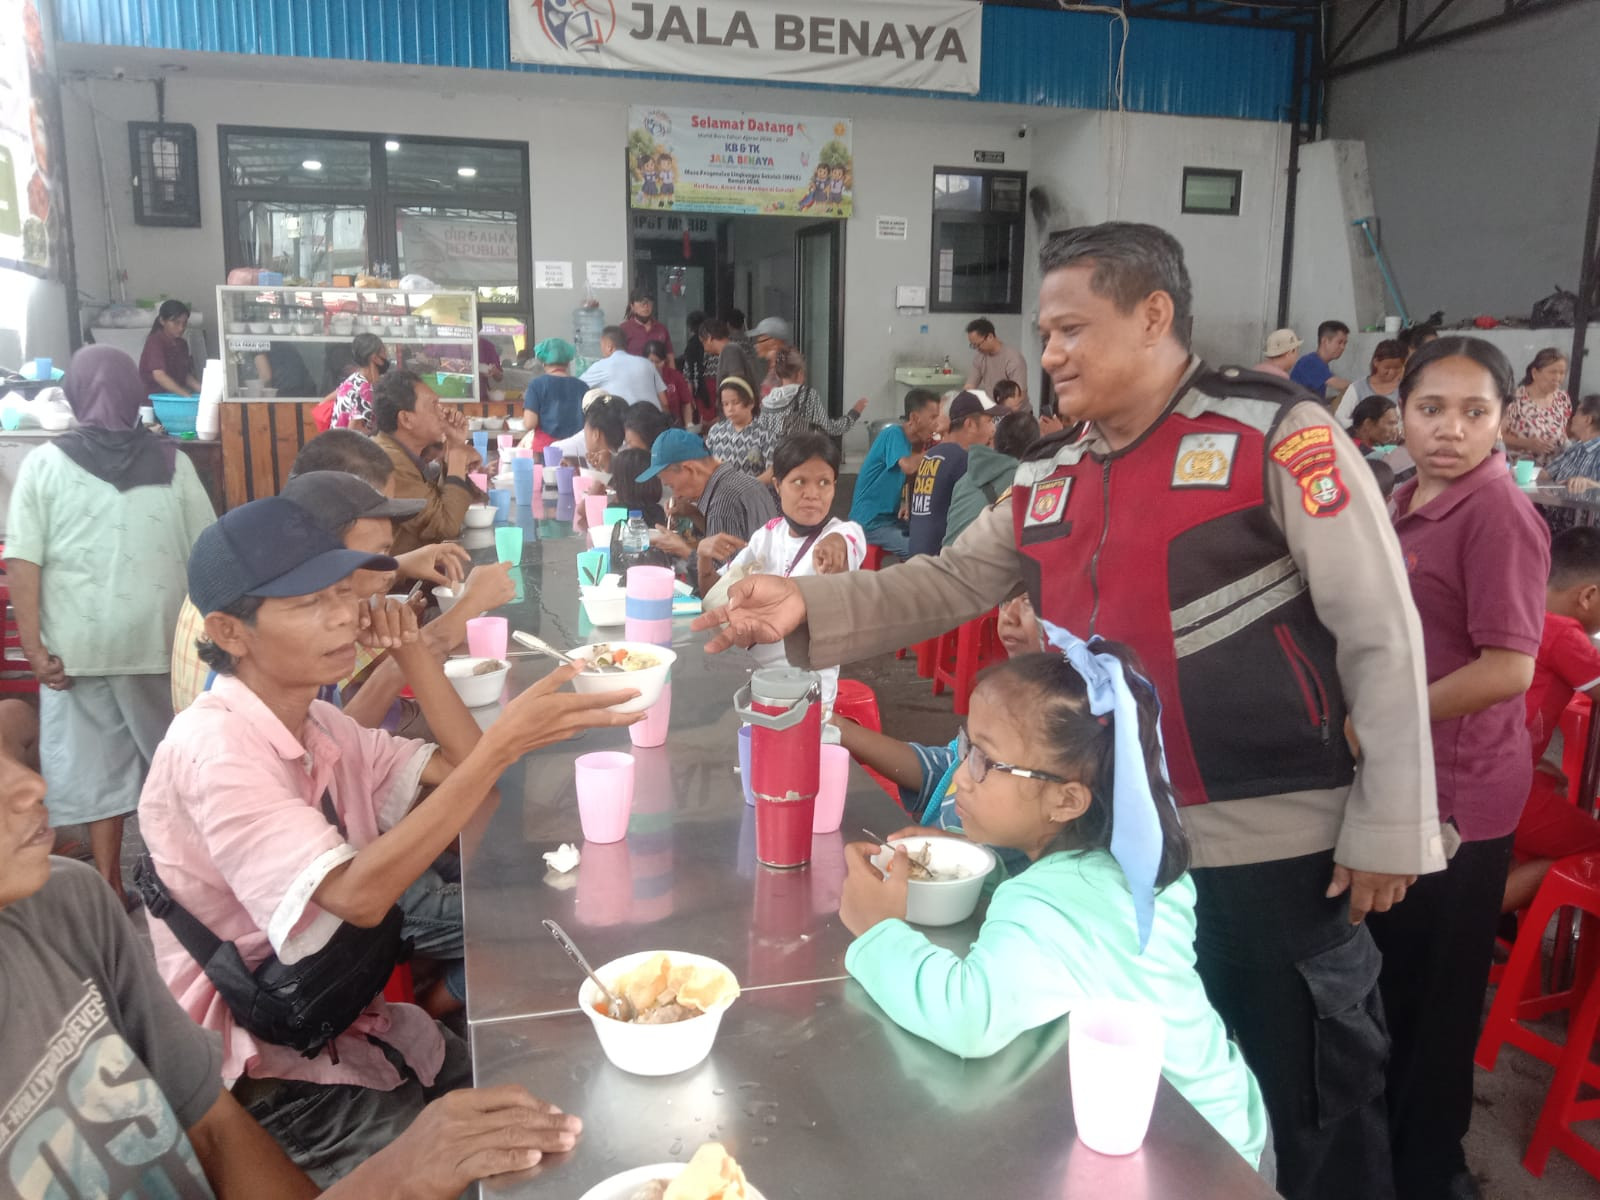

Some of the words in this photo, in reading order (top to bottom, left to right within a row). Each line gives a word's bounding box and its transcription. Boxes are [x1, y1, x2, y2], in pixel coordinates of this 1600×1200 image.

[629, 1, 760, 49] JALA
[774, 13, 968, 64] BENAYA
[691, 115, 745, 131] Selamat
[747, 118, 794, 136] Datang
[725, 142, 738, 153] KB
[748, 143, 760, 153] TK
[710, 153, 734, 164] JALA
[737, 155, 774, 167] BENAYA
